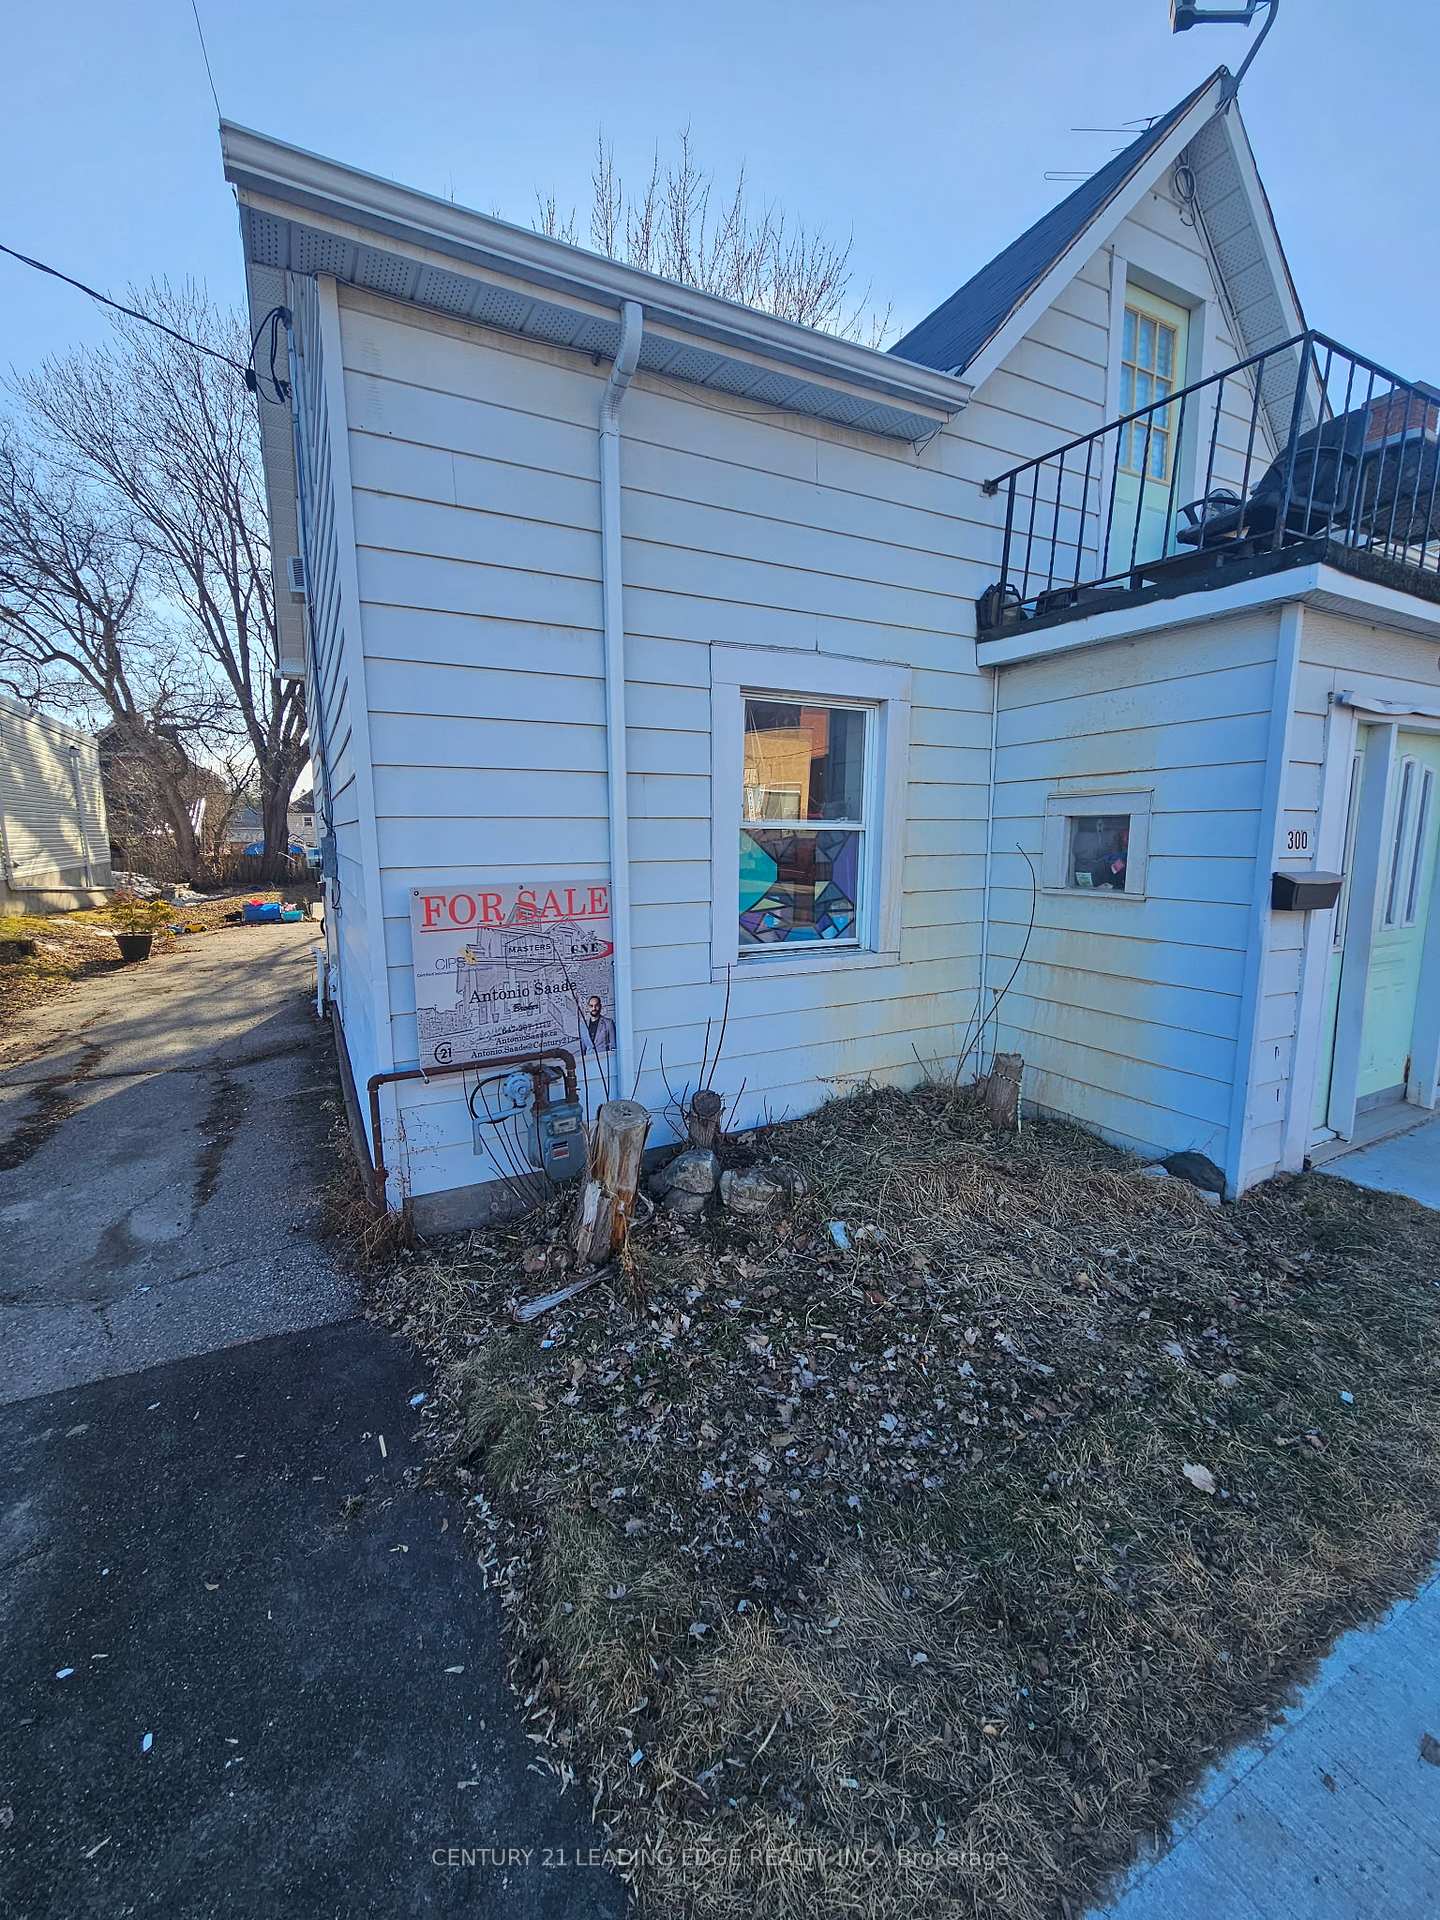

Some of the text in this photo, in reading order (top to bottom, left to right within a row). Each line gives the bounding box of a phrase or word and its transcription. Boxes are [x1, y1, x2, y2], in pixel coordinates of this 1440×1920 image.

[1287, 831, 1308, 850] 300
[420, 886, 610, 928] FOR SALE
[508, 943, 551, 953] MASTERS
[469, 981, 577, 1004] Antonio Saade
